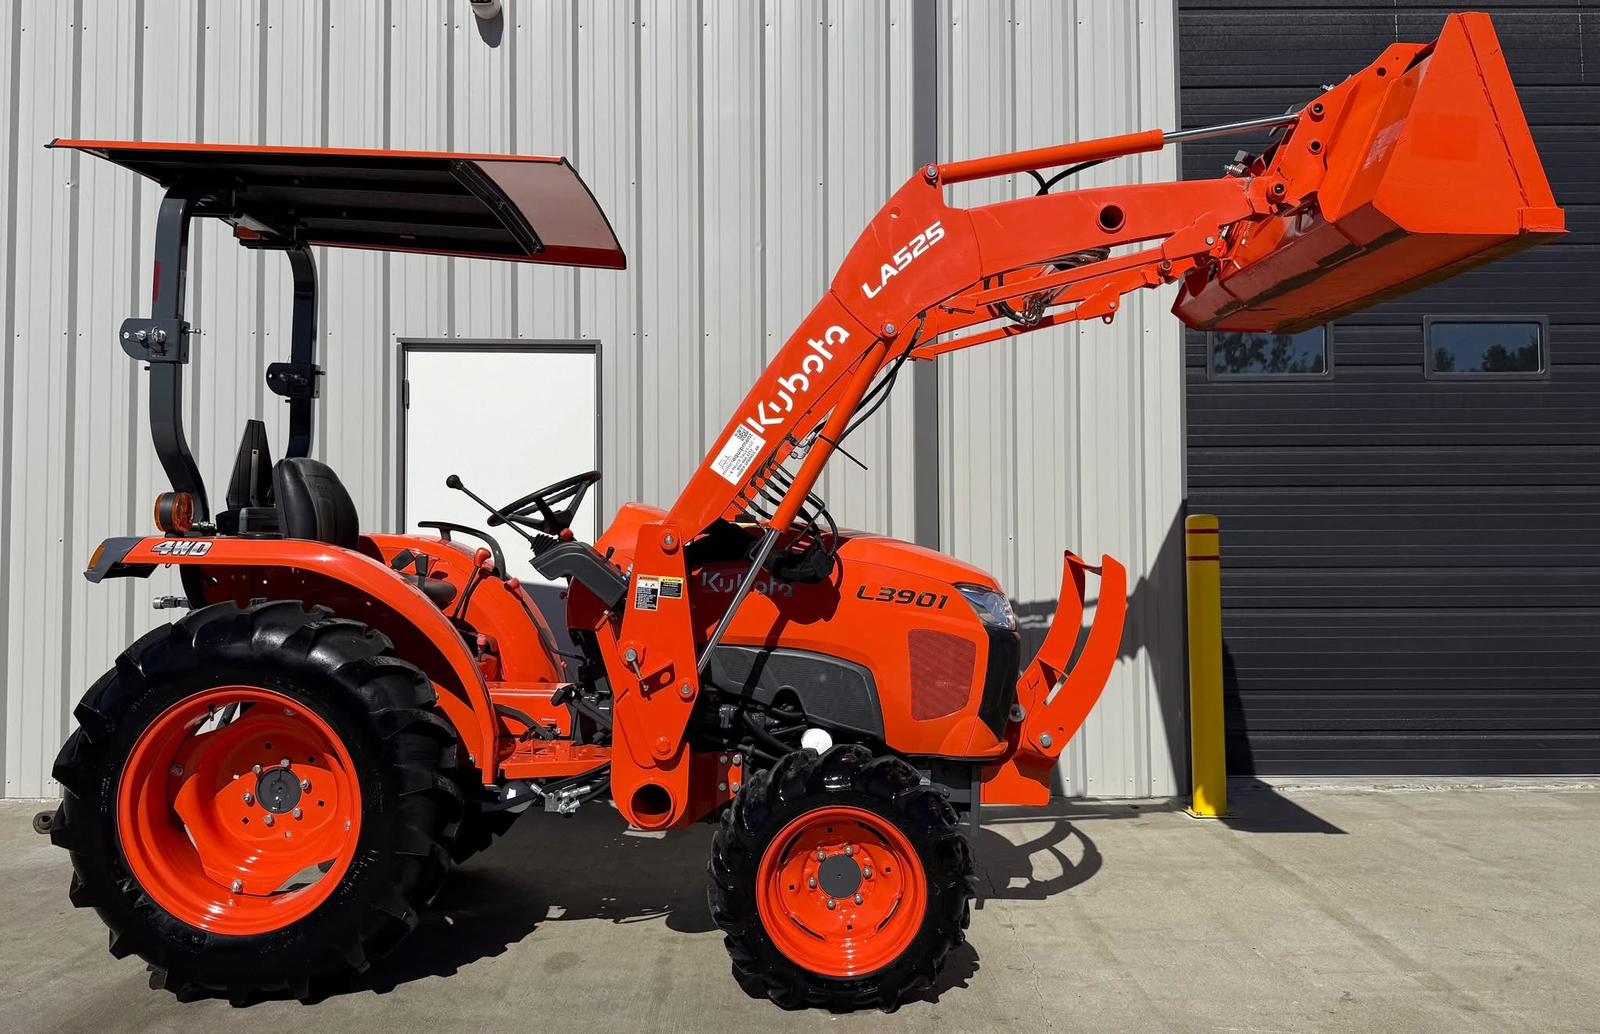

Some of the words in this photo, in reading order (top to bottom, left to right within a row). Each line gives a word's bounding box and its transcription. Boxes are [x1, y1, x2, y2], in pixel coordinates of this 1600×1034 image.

[862, 221, 945, 299] LA525
[746, 325, 850, 434] Kubota
[151, 540, 213, 556] 4WD
[702, 571, 793, 597] Kuota
[856, 585, 949, 609] L3901
